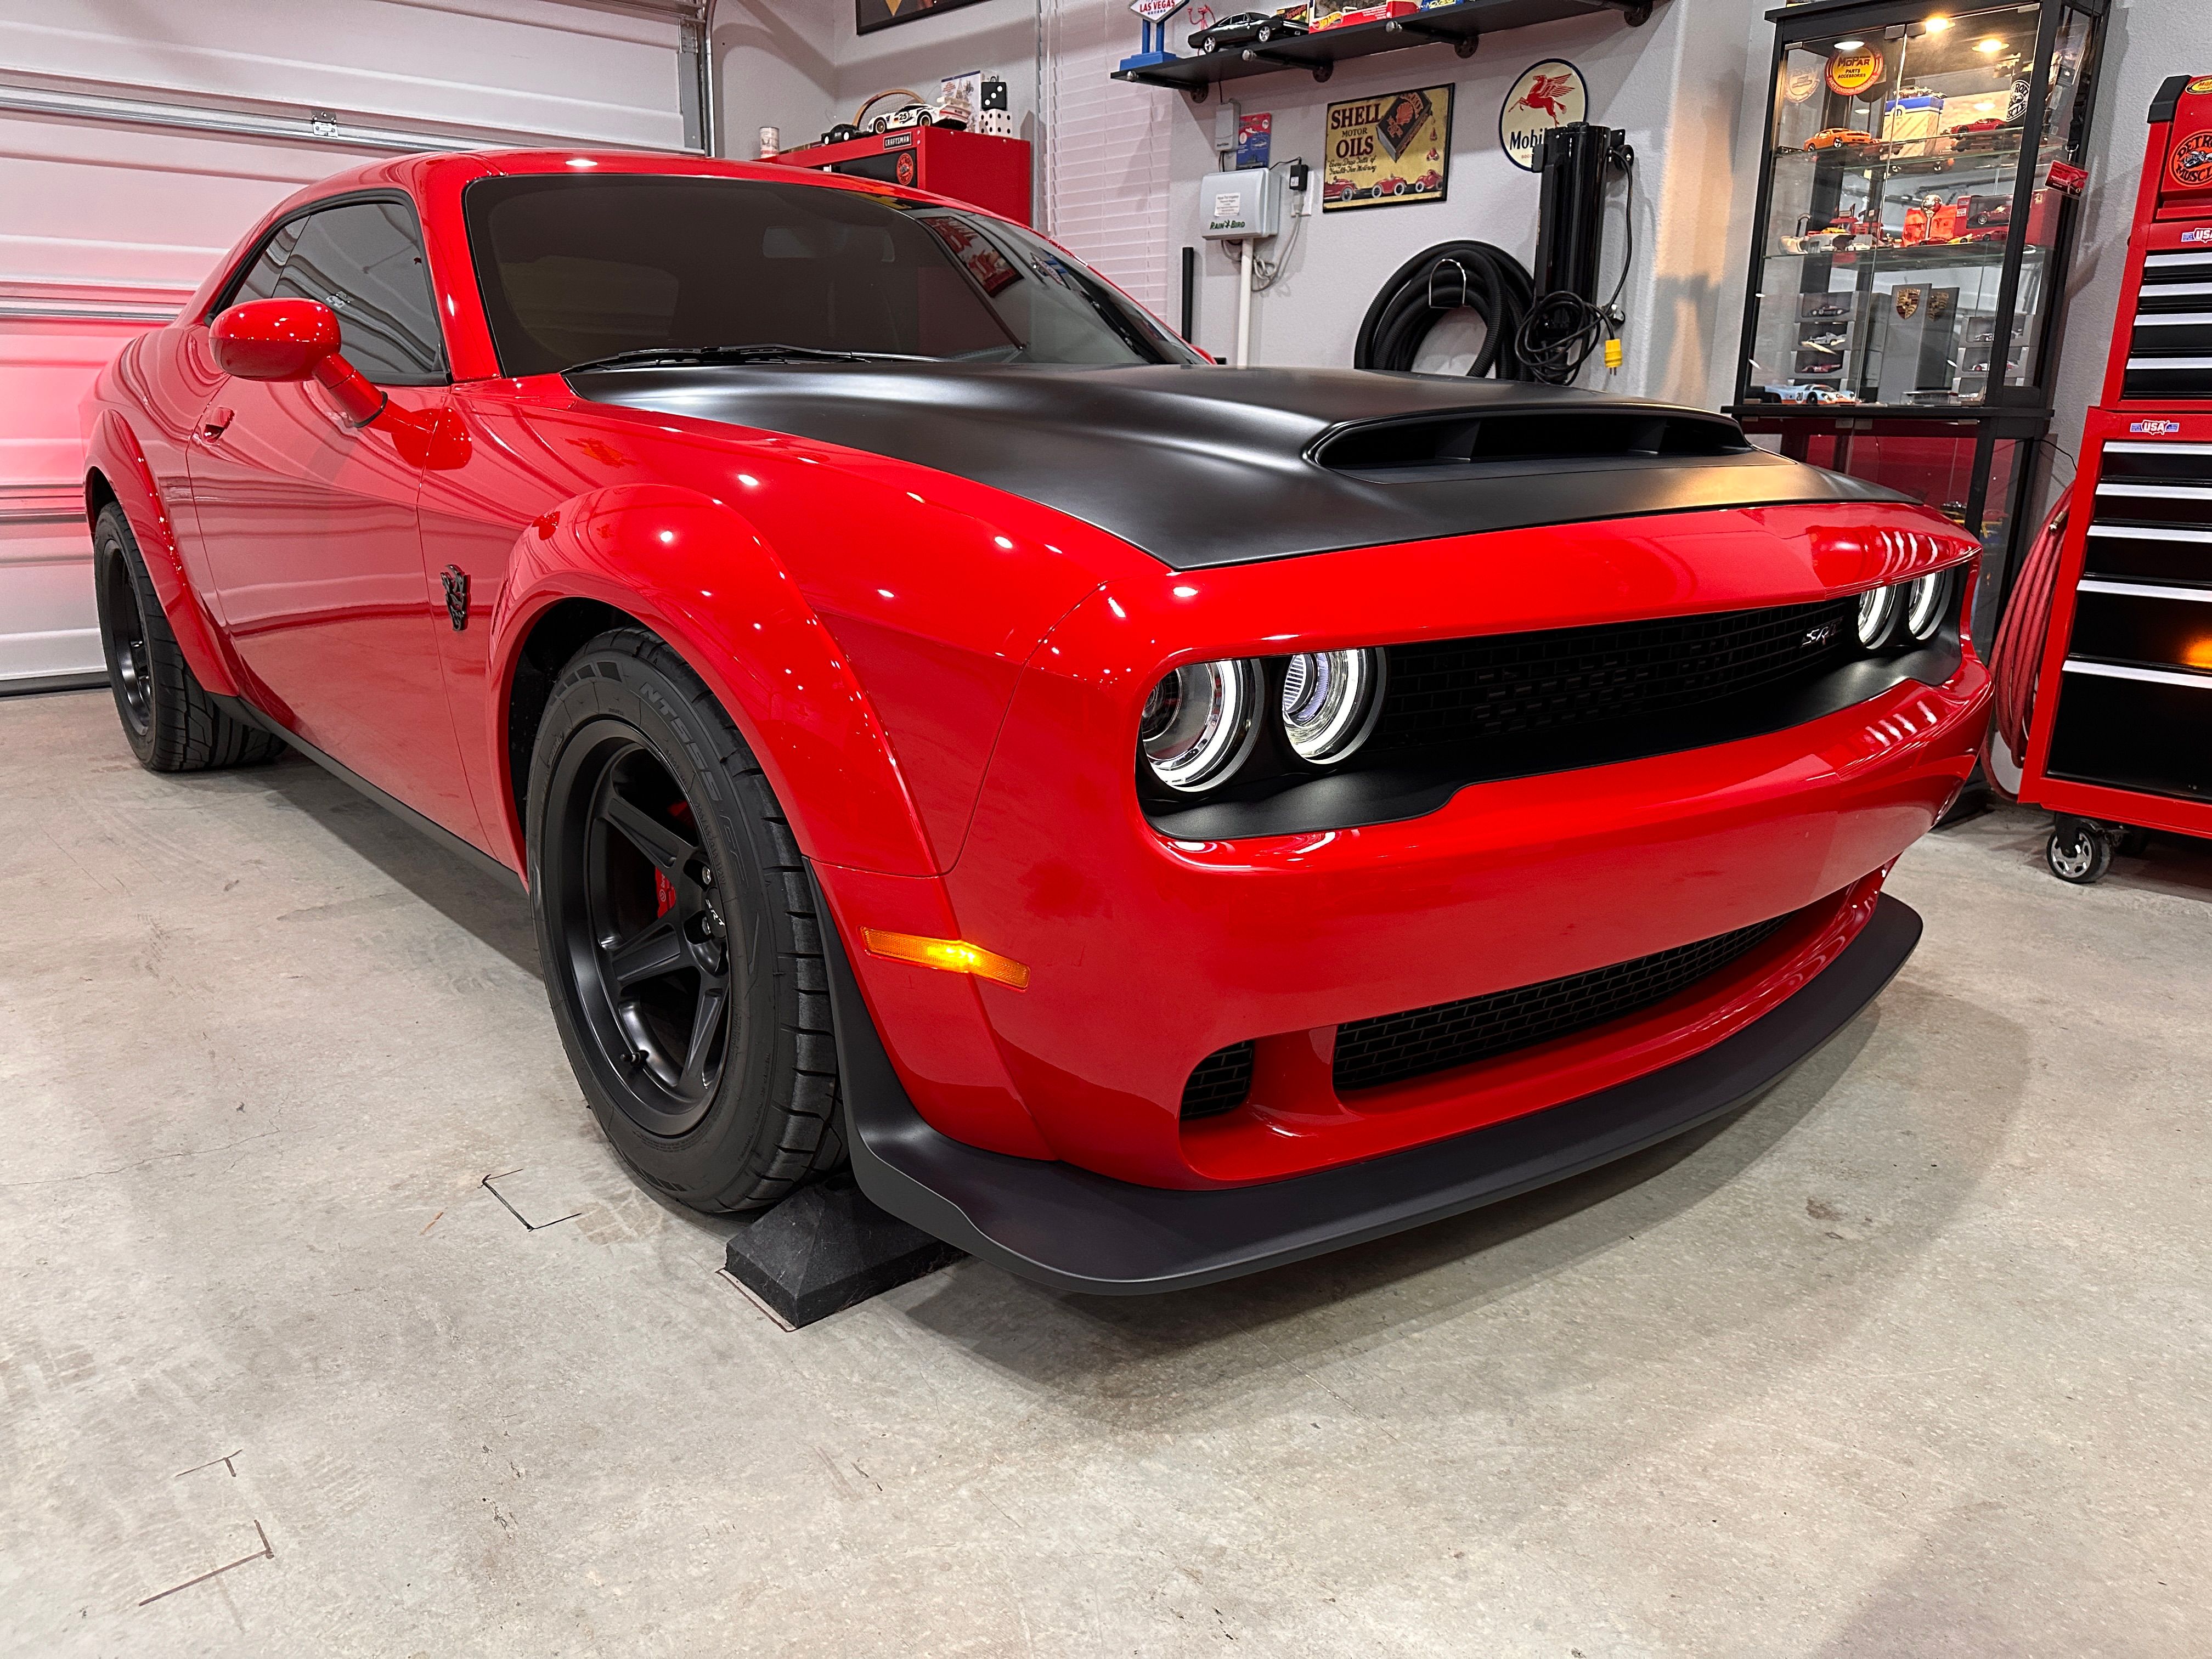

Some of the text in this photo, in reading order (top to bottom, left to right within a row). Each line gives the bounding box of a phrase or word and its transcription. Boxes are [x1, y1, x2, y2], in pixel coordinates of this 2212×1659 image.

[1140, 0, 1175, 12] LAS VEGAS
[1331, 103, 1382, 130] SHELL
[885, 136, 910, 146] CRAFTSMAN
[1342, 127, 1368, 138] MOTOR
[1510, 128, 1547, 150] Mobi
[1336, 136, 1374, 158] OILS
[2177, 135, 2212, 161] DETR
[2176, 163, 2212, 182] MUSCL
[2143, 422, 2164, 431] USA
[639, 682, 723, 802] NT555
[705, 899, 725, 926] SRT
